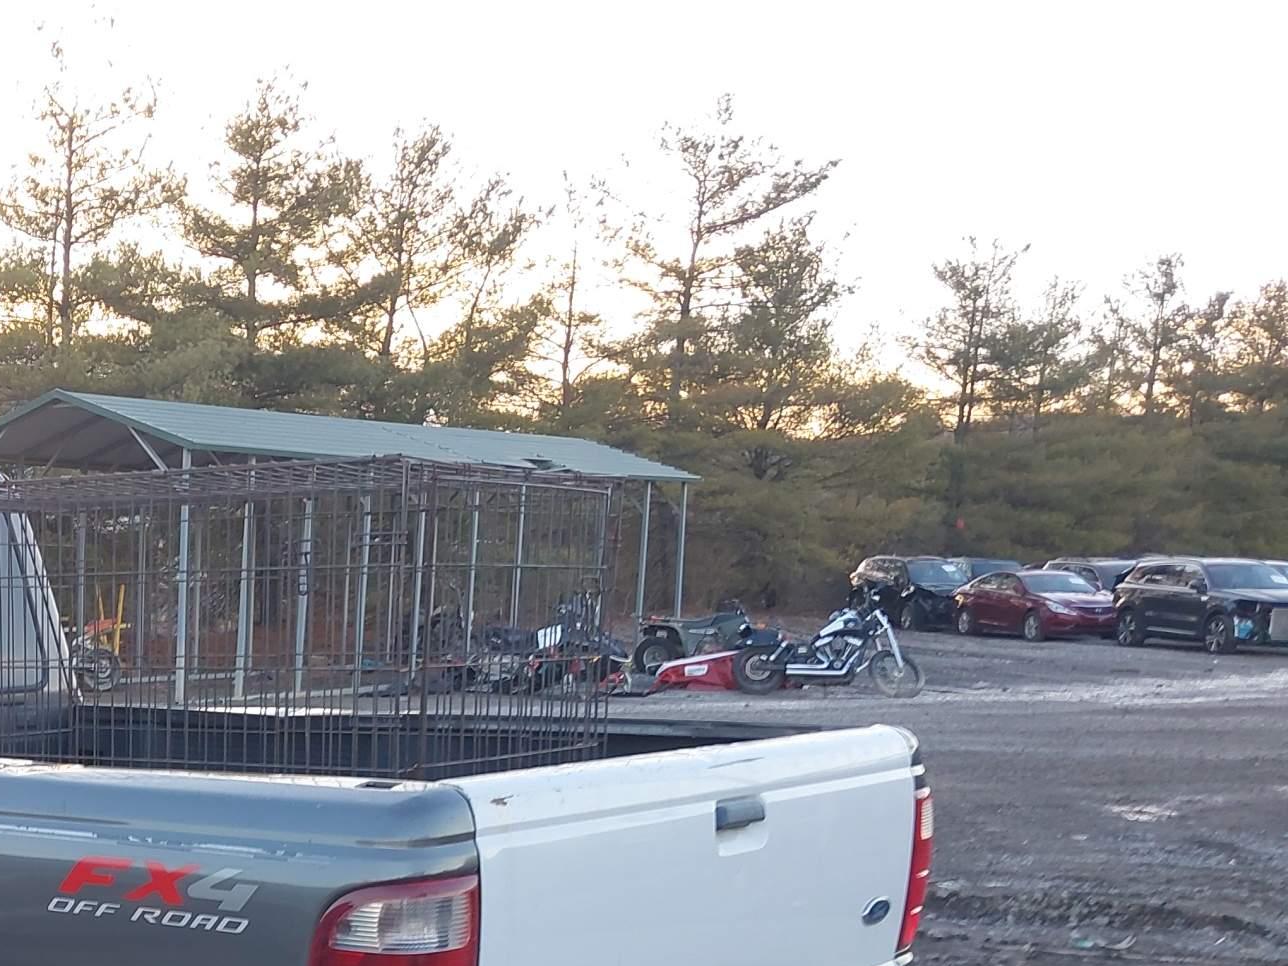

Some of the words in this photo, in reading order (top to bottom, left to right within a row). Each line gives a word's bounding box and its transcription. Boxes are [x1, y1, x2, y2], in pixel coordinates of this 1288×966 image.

[58, 856, 260, 912] FX4
[47, 897, 120, 917] OFF
[130, 907, 249, 934] ROAD
